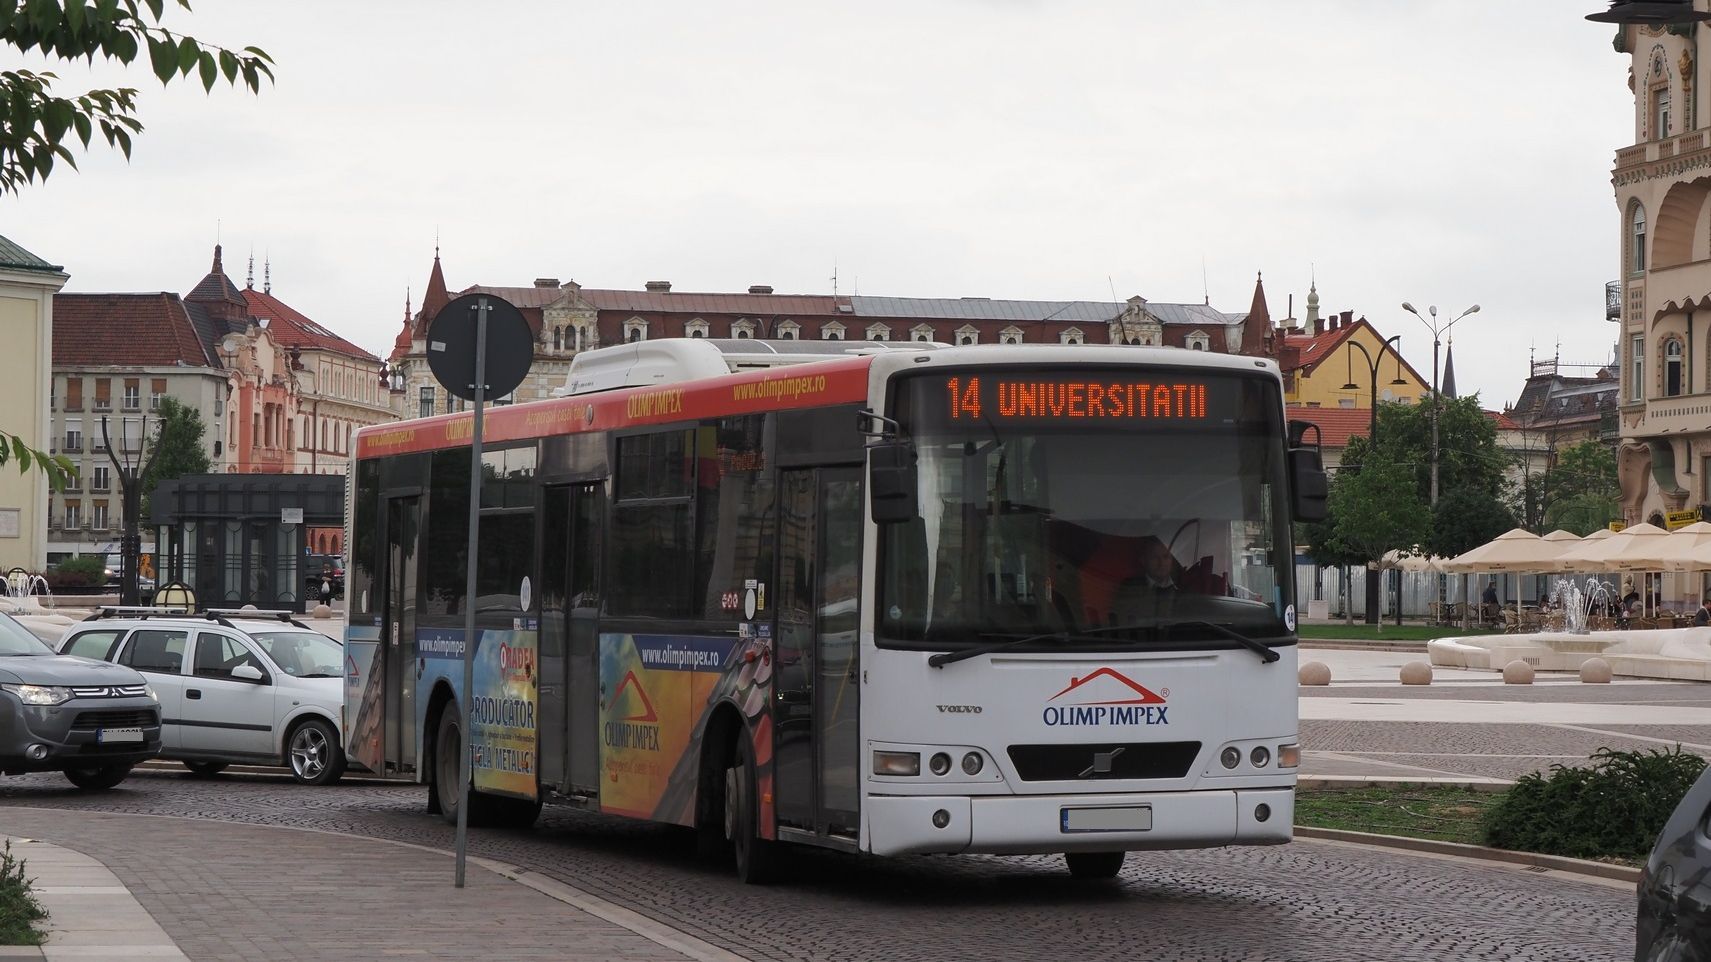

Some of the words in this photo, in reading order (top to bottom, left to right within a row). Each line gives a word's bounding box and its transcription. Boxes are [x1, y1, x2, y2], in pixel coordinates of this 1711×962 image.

[733, 374, 825, 401] www.olimpimpex.ro
[948, 377, 981, 419] 14
[999, 382, 1207, 419] UNIVERSITATII
[641, 645, 719, 671] www.olimpimpex.ro
[936, 705, 983, 714] VOLVO
